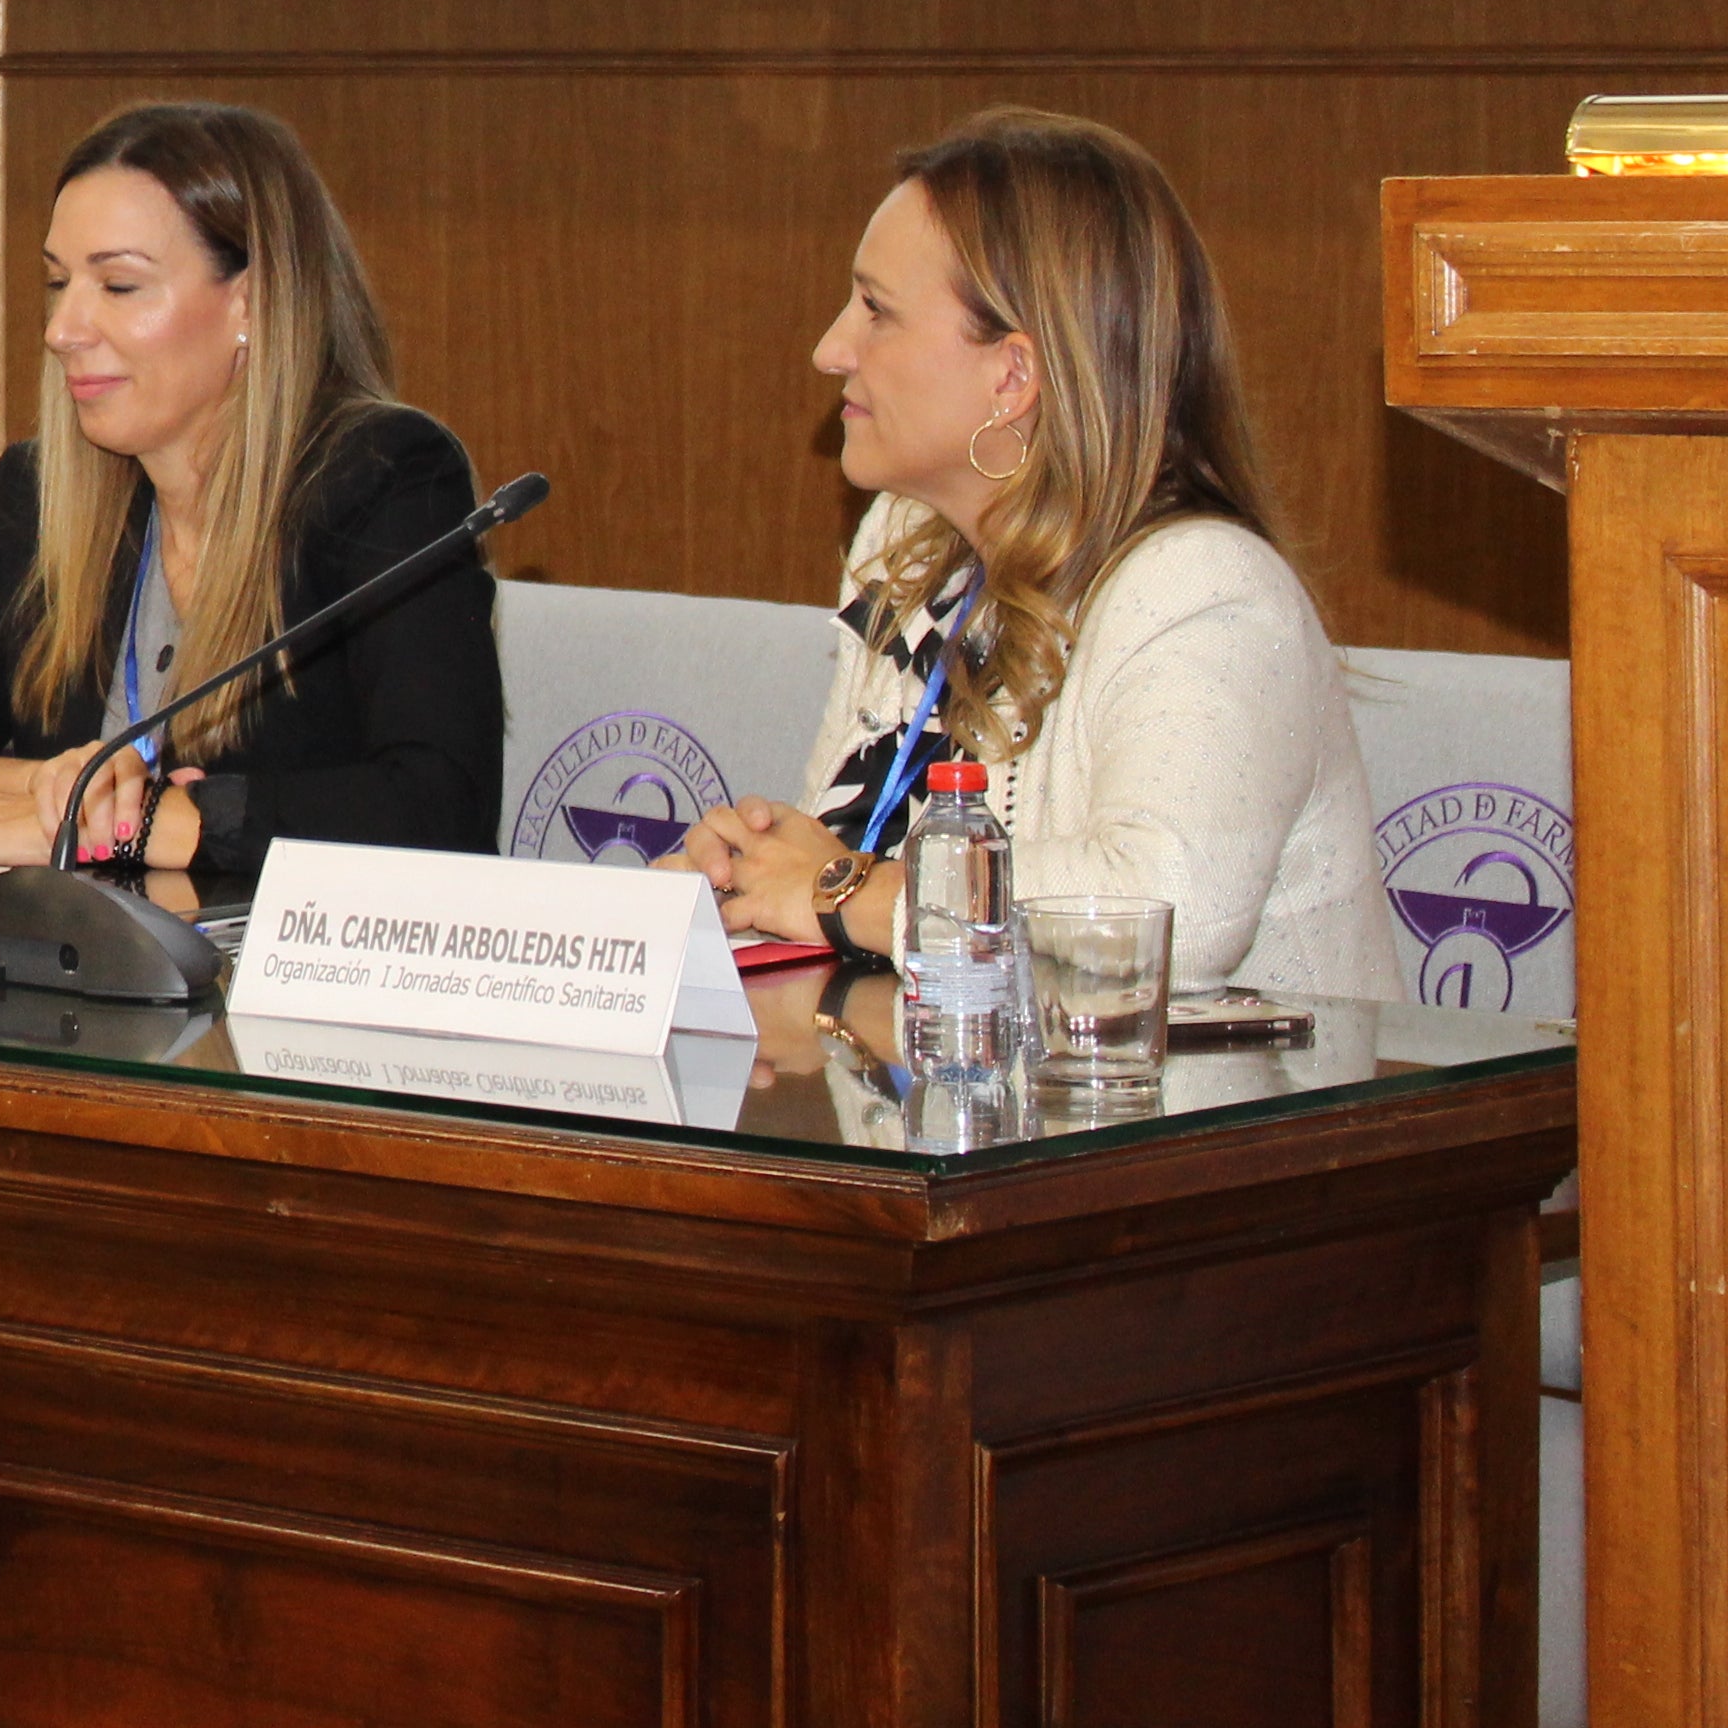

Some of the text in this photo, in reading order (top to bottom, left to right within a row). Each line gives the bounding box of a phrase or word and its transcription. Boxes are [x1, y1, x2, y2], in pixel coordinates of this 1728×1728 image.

[277, 902, 647, 976] DÑA. CARMEN ARBOLEDAS HITA
[264, 953, 646, 1015] Organización I Jornadas Científico Sanitarias
